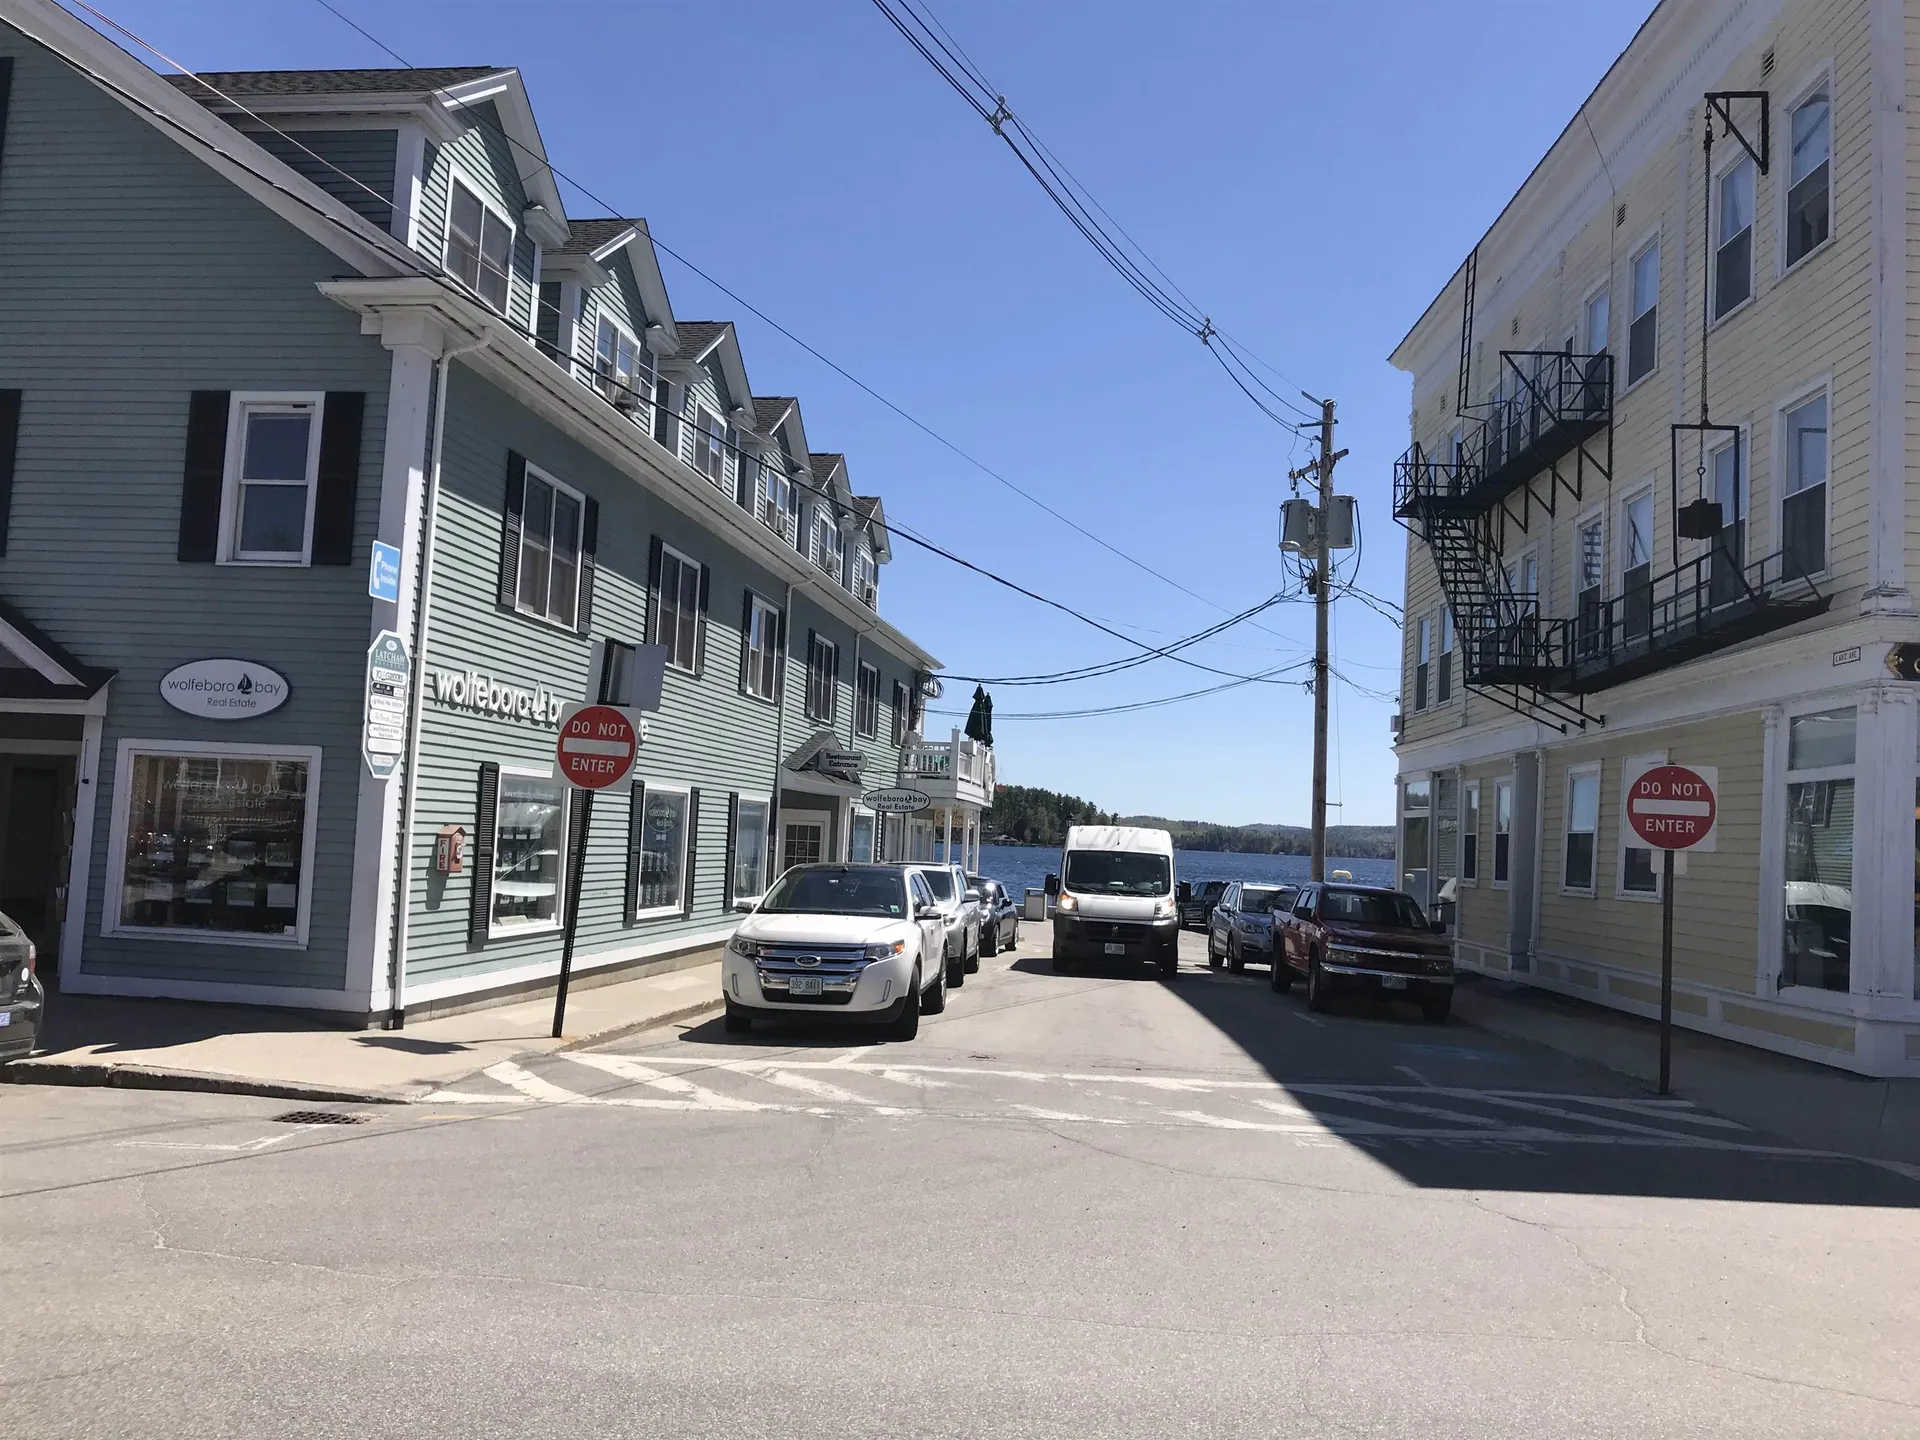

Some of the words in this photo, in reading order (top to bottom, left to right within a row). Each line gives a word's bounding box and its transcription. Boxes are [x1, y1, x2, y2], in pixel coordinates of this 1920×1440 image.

[168, 679, 235, 693] wolfeboro
[255, 681, 281, 696] bay
[435, 671, 529, 717] wolfeboro
[207, 698, 227, 707] Real
[229, 698, 257, 708] Estate
[571, 720, 591, 734] DO
[598, 722, 627, 737] NOT
[825, 752, 862, 761] Restaurant
[828, 760, 858, 768] Entrance
[571, 757, 616, 774] ENTER
[252, 780, 280, 796] bay
[1641, 781, 1661, 795] DO
[1672, 783, 1702, 796] NOT
[866, 793, 905, 803] wolfeboro
[913, 794, 928, 804] bay
[1645, 818, 1695, 834] ENTER
